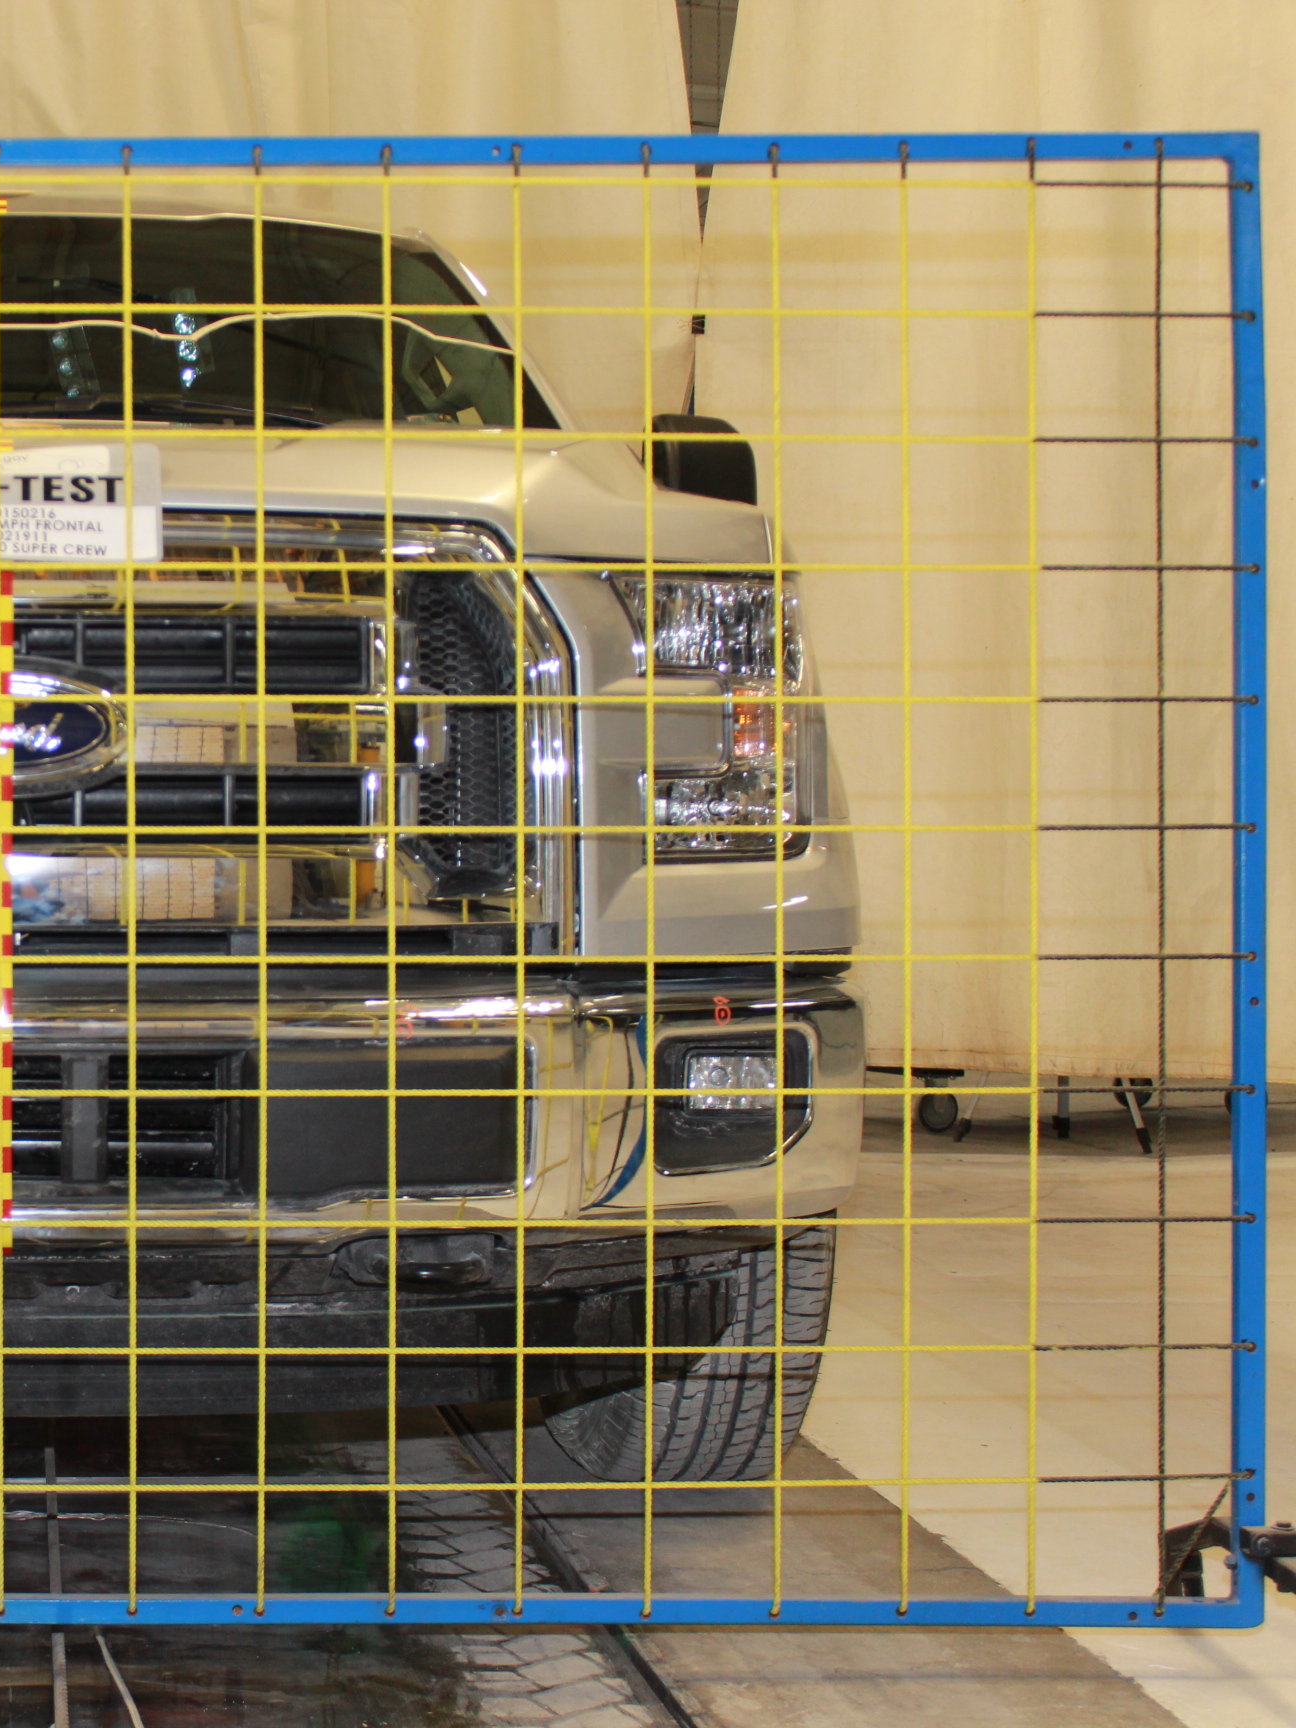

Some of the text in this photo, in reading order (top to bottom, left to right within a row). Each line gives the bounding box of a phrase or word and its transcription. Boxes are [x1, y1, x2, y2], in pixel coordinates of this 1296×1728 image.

[35, 519, 104, 532] FRONTAL
[12, 542, 58, 554] SUPER
[63, 543, 107, 556] CREW
